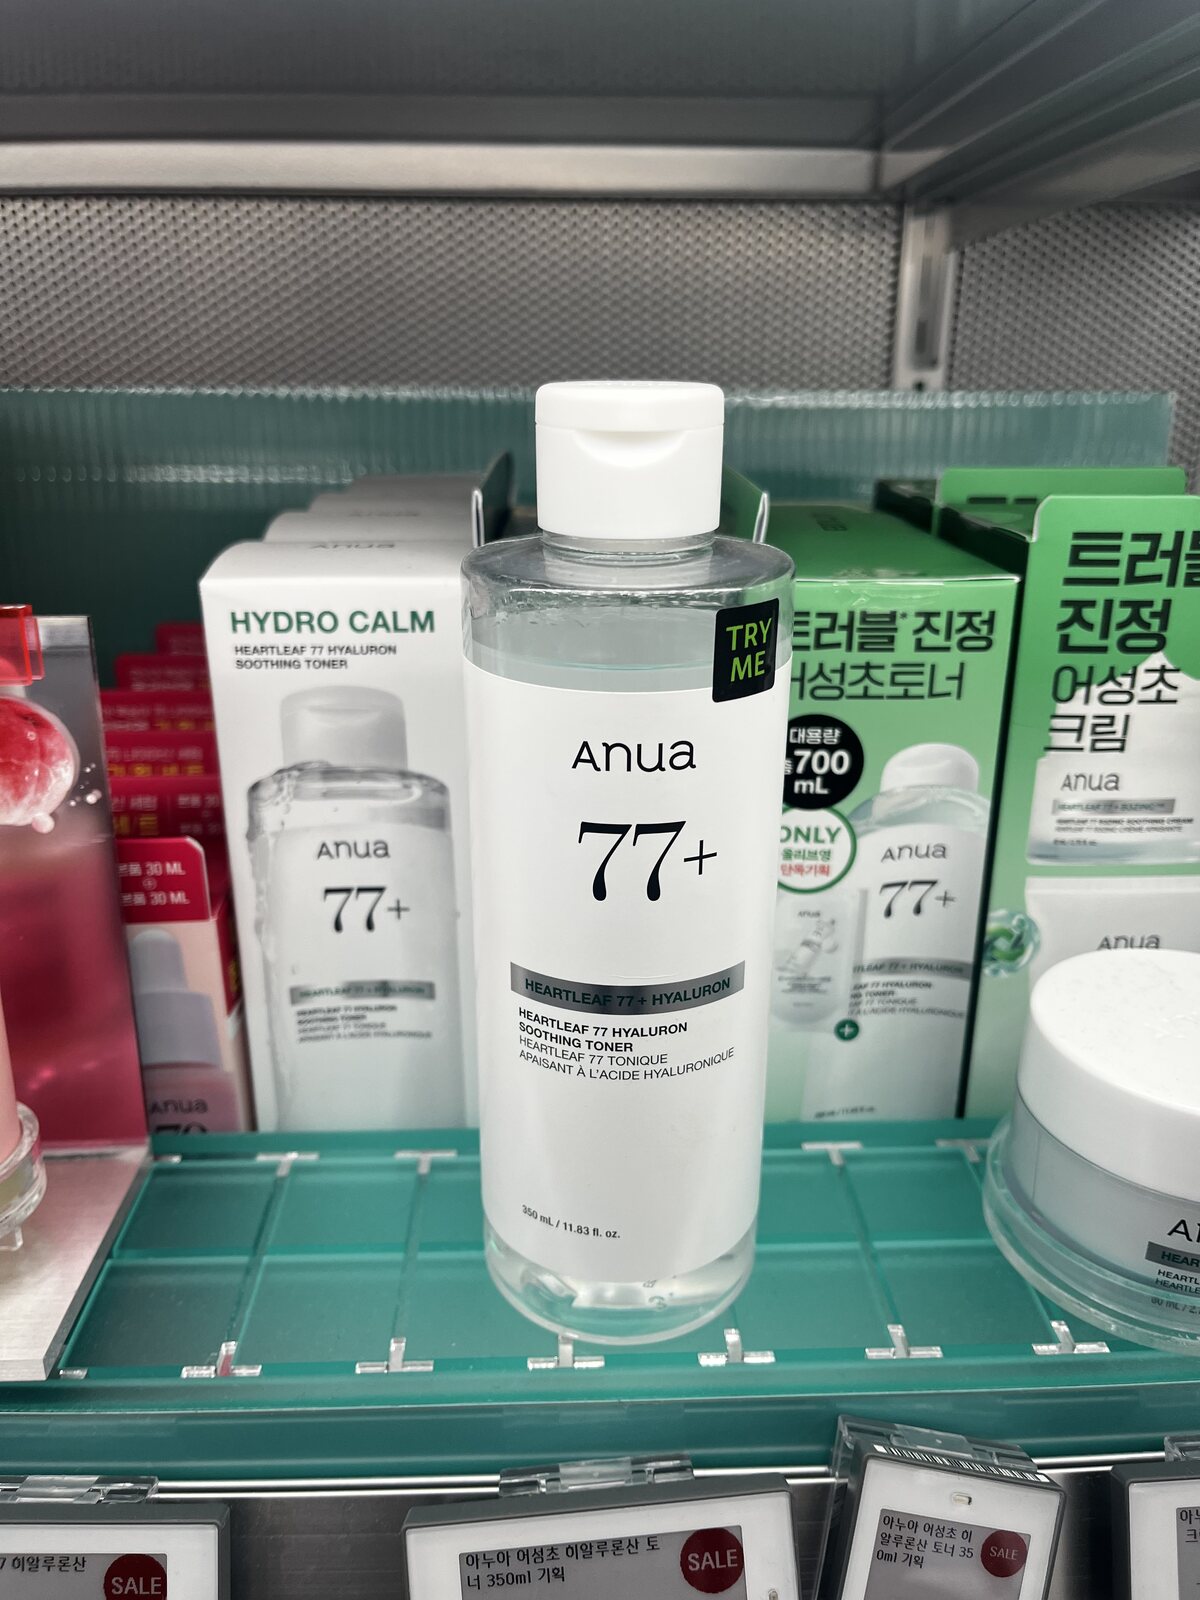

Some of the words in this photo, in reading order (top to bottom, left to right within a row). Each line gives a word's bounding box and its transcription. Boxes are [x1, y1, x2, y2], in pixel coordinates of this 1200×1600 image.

[1062, 530, 1200, 588] 트러
[230, 610, 339, 635] HYDRO
[348, 610, 435, 634] CALM
[725, 617, 773, 651] TRY
[912, 609, 996, 653] 진정
[1056, 598, 1172, 655] 진정
[234, 645, 307, 656] HEARTLEAF
[310, 645, 324, 656] 77
[327, 645, 397, 656] HYALURON
[235, 659, 301, 670] SOOTHING
[306, 659, 348, 670] TONER
[730, 650, 766, 682] ME
[1051, 664, 1181, 706] 어성초
[789, 728, 841, 745] 대용량
[1043, 714, 1130, 754] 크림
[571, 740, 697, 772] Anua
[794, 776, 830, 795] mL
[1060, 771, 1120, 792] Anua
[316, 839, 391, 860] Anua
[577, 820, 718, 902] 77+
[782, 848, 832, 862] 올리브영
[880, 842, 947, 863] Anua
[323, 886, 410, 933] 77+
[879, 879, 957, 919] 77+
[1098, 934, 1161, 950] Anua
[525, 978, 612, 1007] HEARTLEAF
[616, 995, 634, 1007] 77
[638, 996, 648, 1006] +
[652, 977, 731, 1006] HYALURON
[518, 1007, 589, 1035] HEARTLEAF
[592, 1026, 608, 1037] 77
[612, 1022, 688, 1038] HYALURON
[518, 1021, 582, 1049] SOOTHING
[585, 1039, 633, 1053] TONER
[519, 1034, 585, 1063] HEARTLEAF
[589, 1054, 604, 1065] 77
[607, 1053, 668, 1067] TONIQUE
[519, 1049, 574, 1076] APAISANT
[576, 1066, 587, 1078] À
[643, 1046, 735, 1080] HYALURONIQUE
[522, 1204, 538, 1219] 350
[539, 1214, 554, 1227] mL
[555, 1219, 560, 1228] /
[563, 1221, 590, 1236] 11.83
[592, 1227, 602, 1237] fl.
[605, 1230, 621, 1239] oz.
[1167, 1219, 1200, 1243] A
[882, 1515, 919, 1534] 아누아
[923, 1522, 958, 1540] 어성초
[465, 1551, 512, 1570] 아누아
[565, 1539, 640, 1560] 히알루론산
[646, 1536, 661, 1552] 토
[687, 1549, 738, 1572] SALE
[880, 1532, 928, 1552] 알루론산
[931, 1541, 955, 1558] 토너
[958, 1546, 974, 1559] 35
[989, 1545, 1019, 1561] SALE
[111, 1576, 162, 1595] SALE
[467, 1574, 481, 1590] 너
[486, 1570, 532, 1588] 350ml
[537, 1566, 566, 1583] 기획
